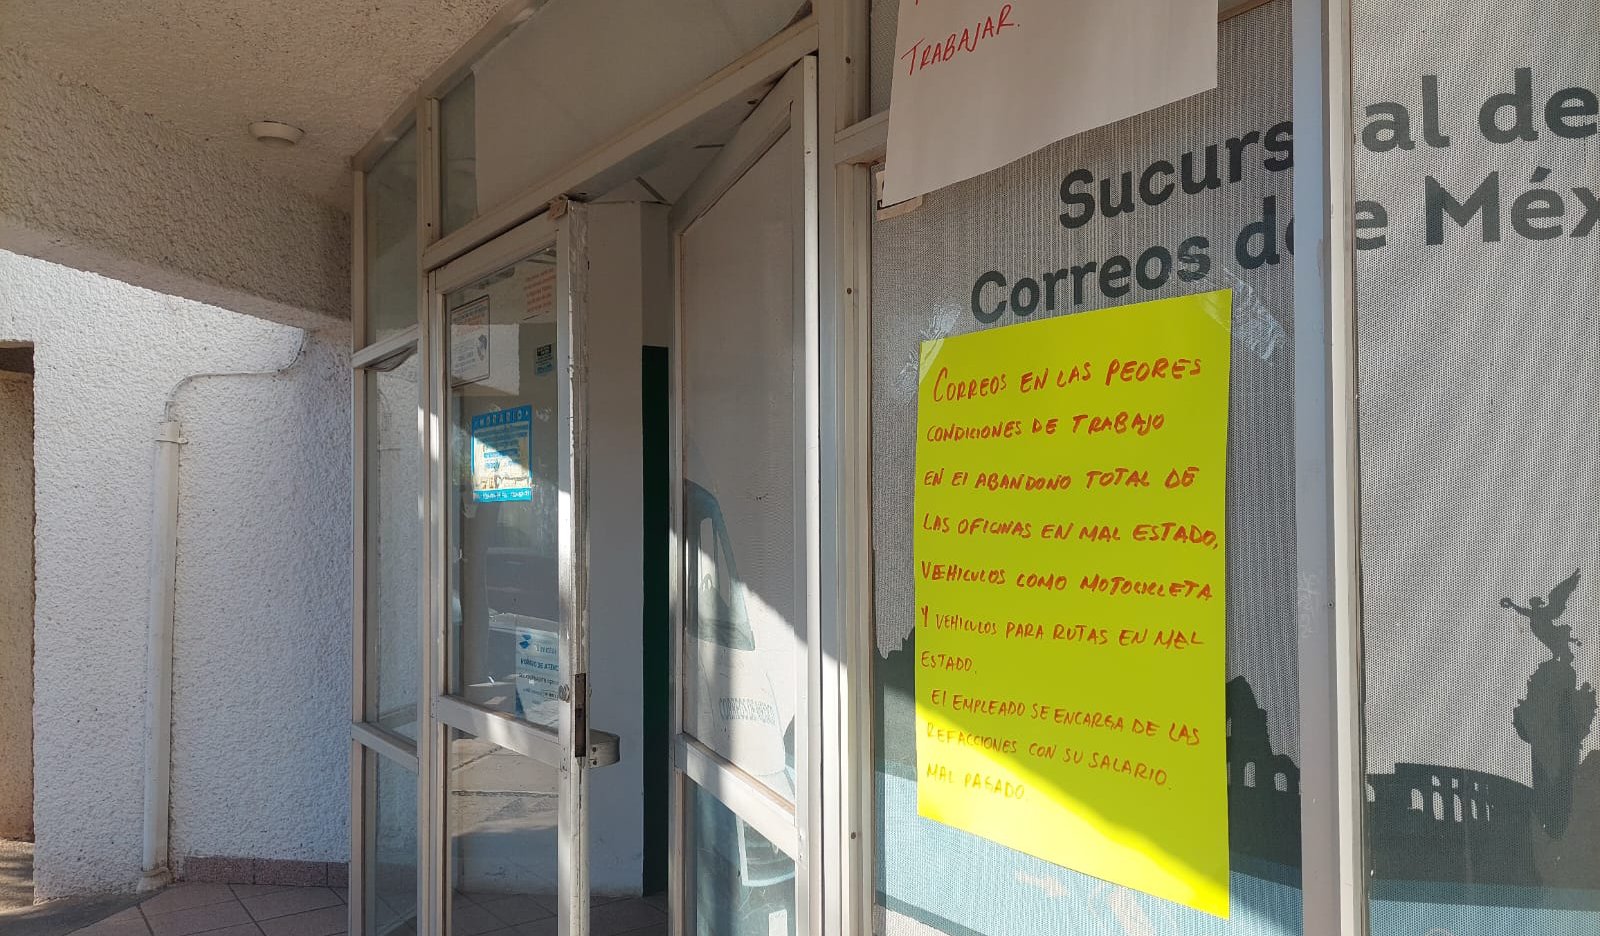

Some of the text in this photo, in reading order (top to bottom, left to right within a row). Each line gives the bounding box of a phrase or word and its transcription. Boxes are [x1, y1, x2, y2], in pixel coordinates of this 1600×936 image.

[901, 4, 1020, 76] TRABAJAR.
[1479, 66, 1600, 145] de
[970, 235, 1211, 324] Correos
[1020, 369, 1048, 392] EN
[1057, 362, 1091, 387] LAS
[1105, 358, 1201, 386] PEORES
[1032, 418, 1059, 434] DE
[1073, 412, 1165, 435] TRABAJO
[924, 468, 944, 486] EN
[975, 472, 1072, 491] ABANDONO
[1086, 468, 1150, 489] TOTAL
[1164, 467, 1200, 489] DE
[923, 513, 950, 533] LAS
[1041, 523, 1073, 540] EN
[1079, 526, 1120, 542] MAL
[921, 561, 1006, 584] VEHICULOS
[1016, 573, 1067, 591] COMO
[921, 605, 928, 628] Y
[936, 614, 997, 635] VEHICULOS
[1005, 622, 1044, 640] PARA
[1053, 625, 1108, 645] RUTAS
[1119, 628, 1147, 646] EN
[952, 694, 1025, 716] EMPLEADO
[1031, 703, 1050, 720] SE
[1132, 718, 1160, 737] DE
[1169, 722, 1200, 746] LAS
[927, 722, 1017, 754] REFACCIONES
[1029, 742, 1056, 759] CON
[1063, 749, 1083, 764] SU
[926, 763, 954, 783] MAL
